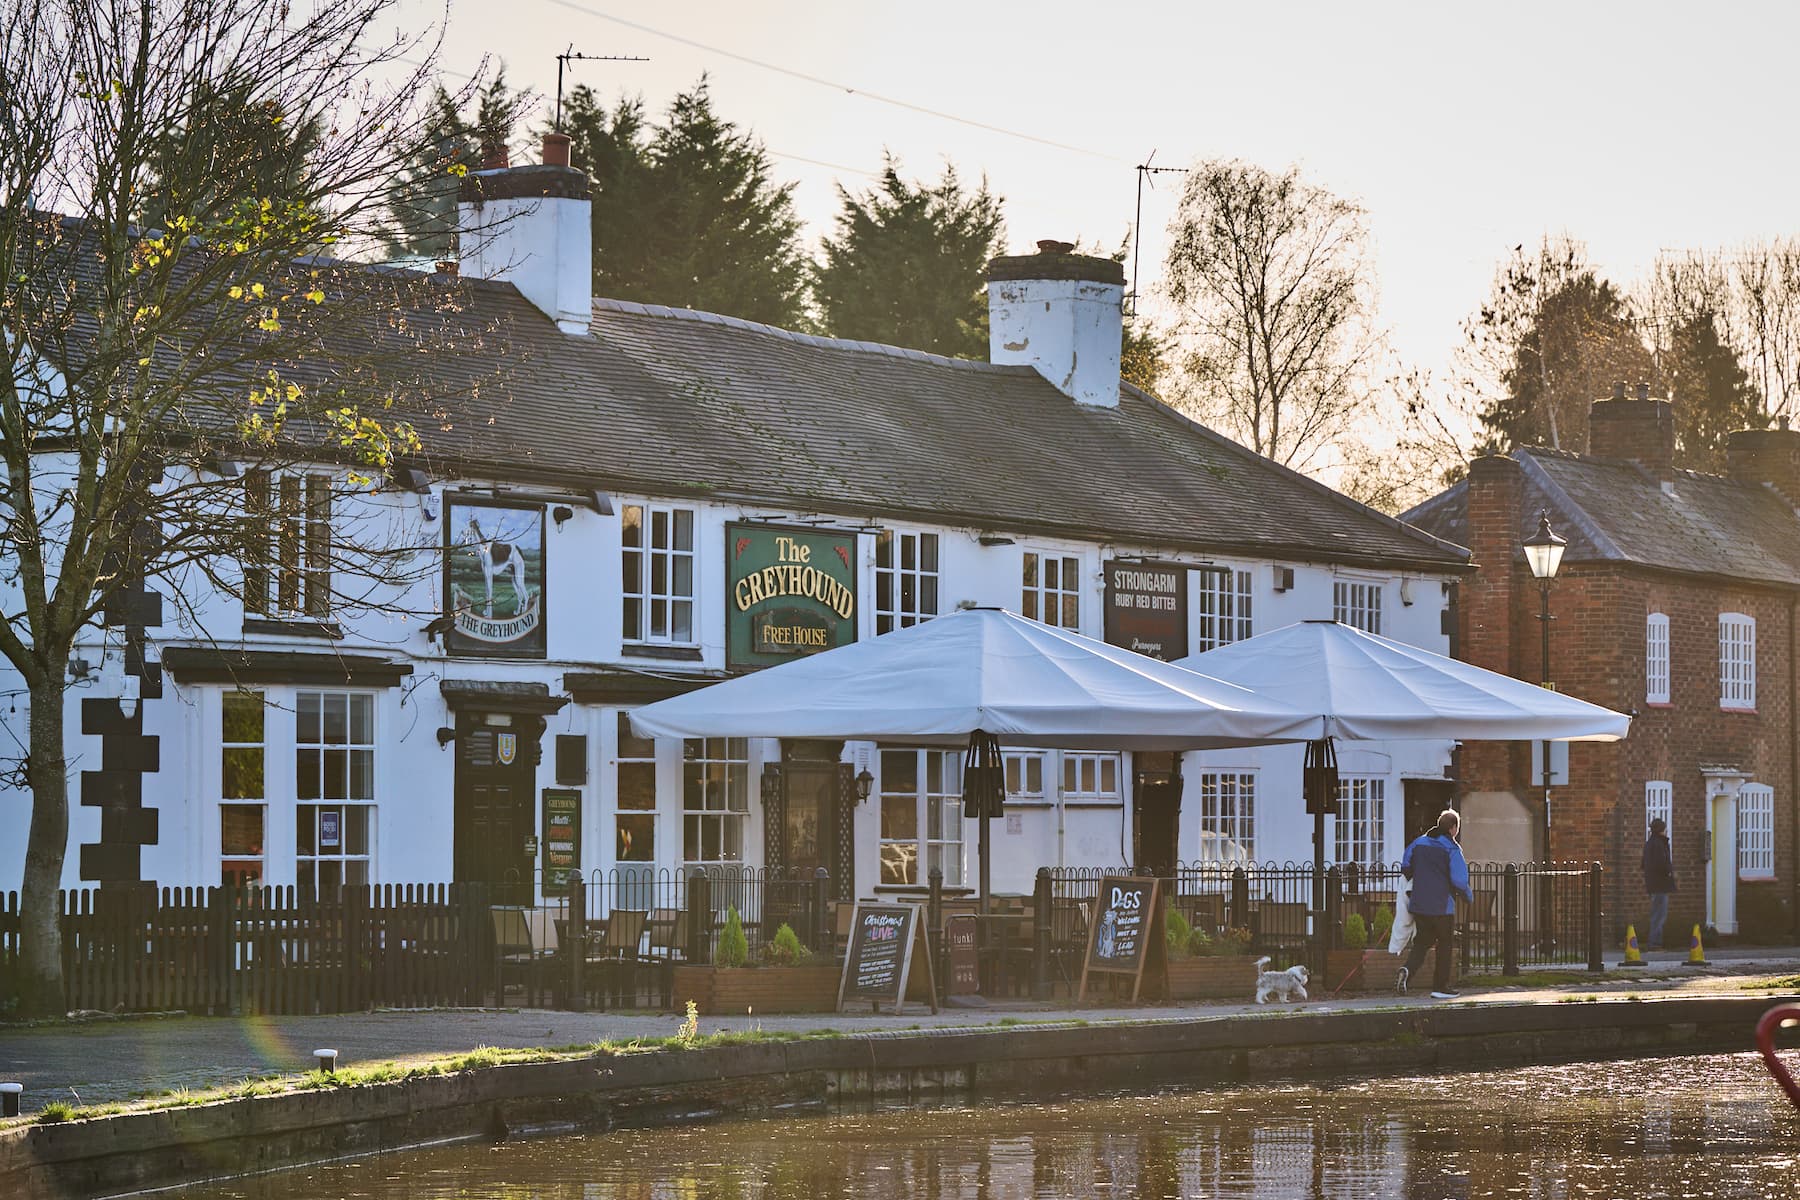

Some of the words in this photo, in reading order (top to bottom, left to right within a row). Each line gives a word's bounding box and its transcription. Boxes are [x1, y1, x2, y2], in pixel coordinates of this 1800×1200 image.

[776, 537, 811, 562] The
[735, 565, 854, 619] GREYHOUND
[1114, 570, 1176, 593] STRONGARM
[1115, 593, 1133, 607] RUBY
[1136, 595, 1150, 609] RED
[1152, 596, 1176, 610] BITTER
[461, 613, 479, 633] THE
[480, 613, 534, 637] GREYHOUND
[763, 625, 792, 645] FREE
[794, 626, 828, 646] HOUSE
[871, 926, 895, 941] LIVE
